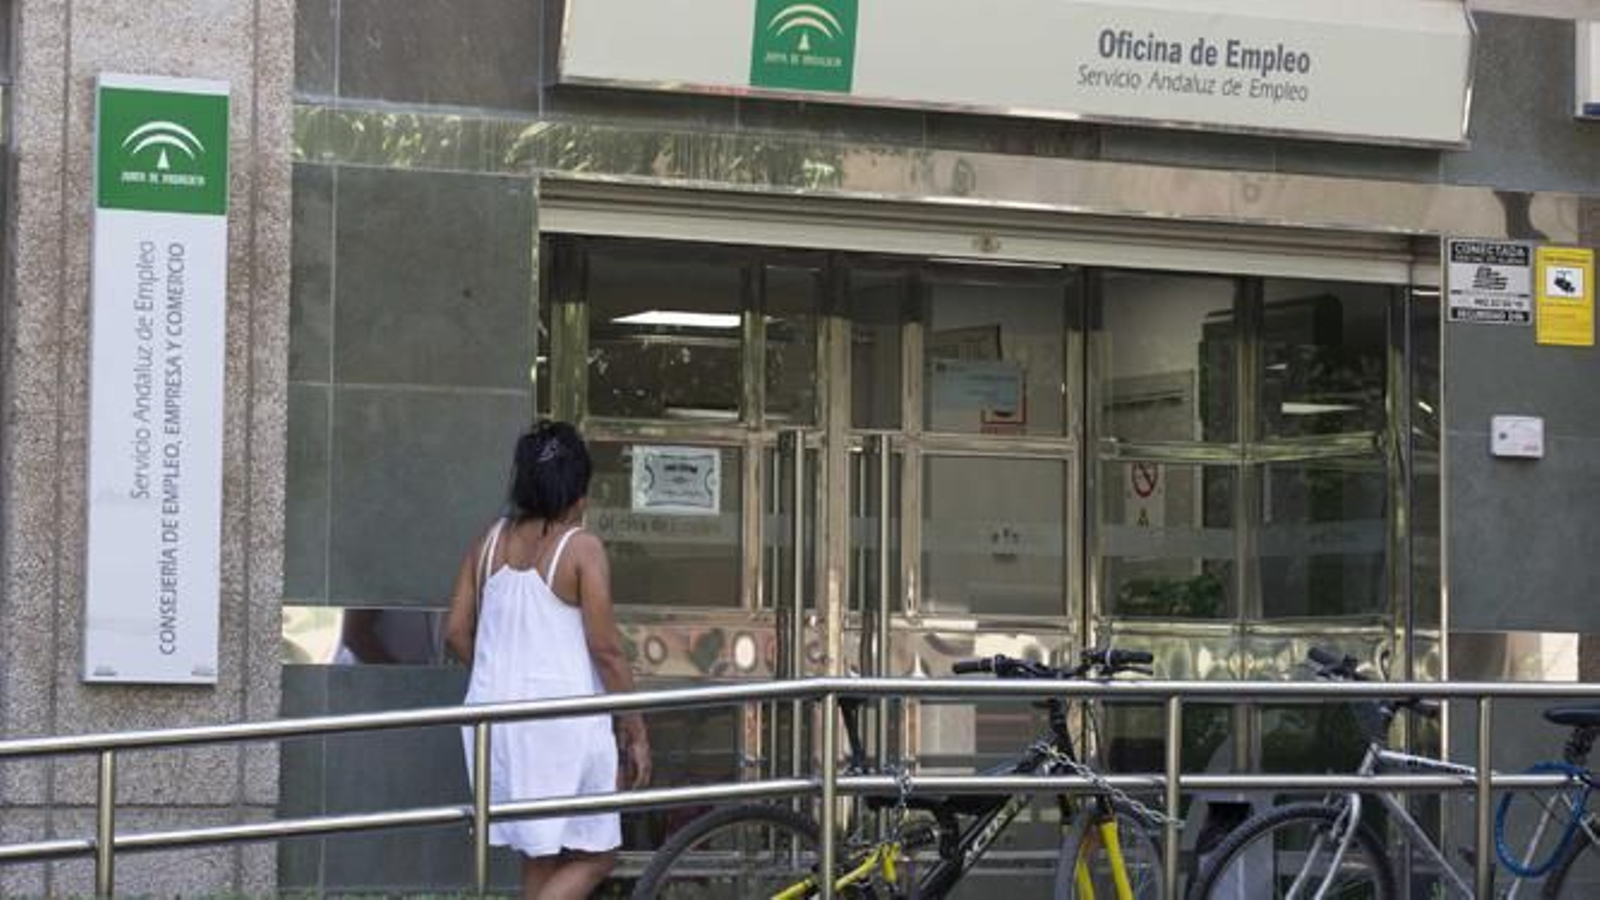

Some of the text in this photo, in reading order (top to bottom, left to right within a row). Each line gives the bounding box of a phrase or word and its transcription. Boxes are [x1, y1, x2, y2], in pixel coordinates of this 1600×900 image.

[1077, 64, 1309, 103] Servicio Andaluz de Empleo
[1099, 29, 1310, 77] Oficina de Empleo
[130, 241, 159, 500] Servicio Andaluz de Empleo
[157, 242, 185, 656] CONSEJERÍA DE EMPLEO, EMPRESA Y COMERCIO
